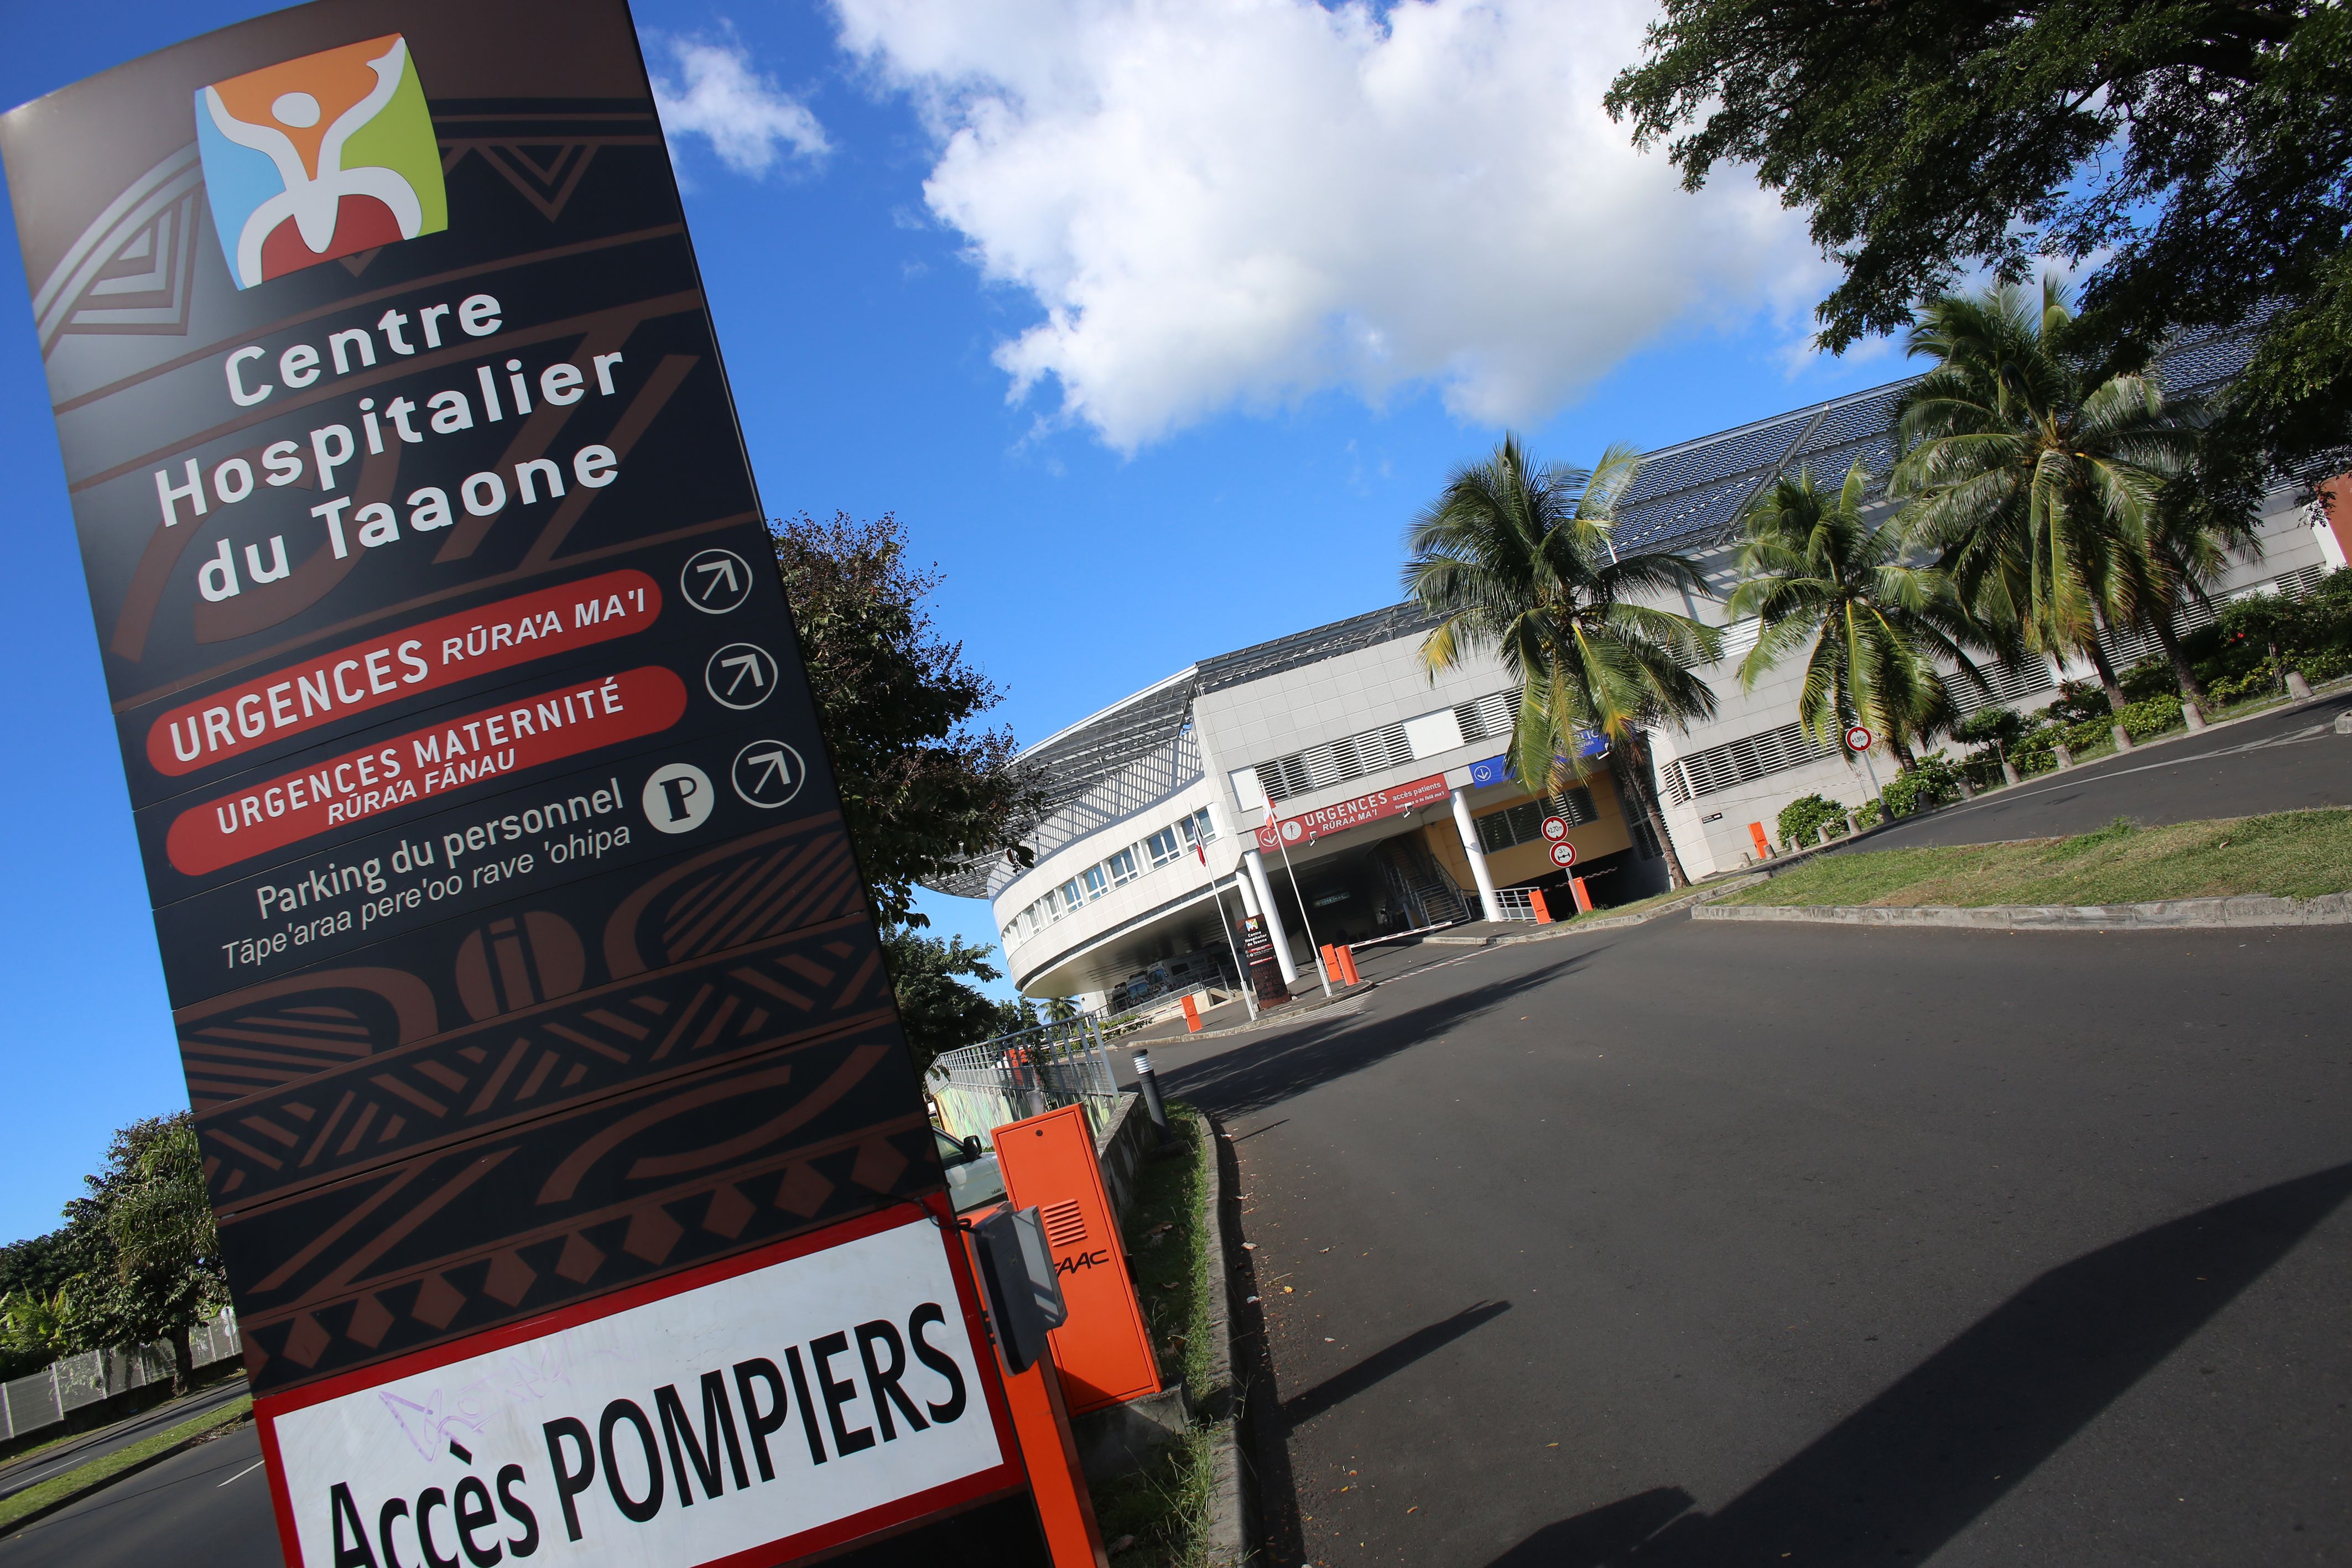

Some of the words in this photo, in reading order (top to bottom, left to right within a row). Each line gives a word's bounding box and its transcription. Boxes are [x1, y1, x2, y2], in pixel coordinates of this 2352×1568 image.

[225, 294, 502, 407] Centre
[154, 351, 623, 528] Hospitalier
[198, 534, 290, 602] du
[311, 444, 618, 560] Taaone
[170, 640, 428, 762] URGENCES
[443, 610, 563, 665] RŪRA'A
[575, 588, 644, 628] MA'I
[217, 748, 400, 834] URGENCES
[413, 676, 624, 768] MATERNITÉ
[425, 748, 514, 794] FĀNAU
[659, 777, 697, 822] P
[1304, 792, 1387, 826] URGENCES
[1393, 791, 1412, 801] accès
[1413, 782, 1441, 796] patients
[1358, 809, 1377, 821] MA'I
[222, 910, 352, 968] Tāpe'araa
[361, 876, 463, 930] pere'oo
[473, 853, 534, 888] rave
[544, 826, 631, 864] 'ohipa
[256, 857, 387, 920] Parking
[392, 840, 434, 874] du
[443, 777, 623, 870] personnel
[330, 1439, 540, 1568] Accès
[542, 1302, 967, 1543] POMPIERS
